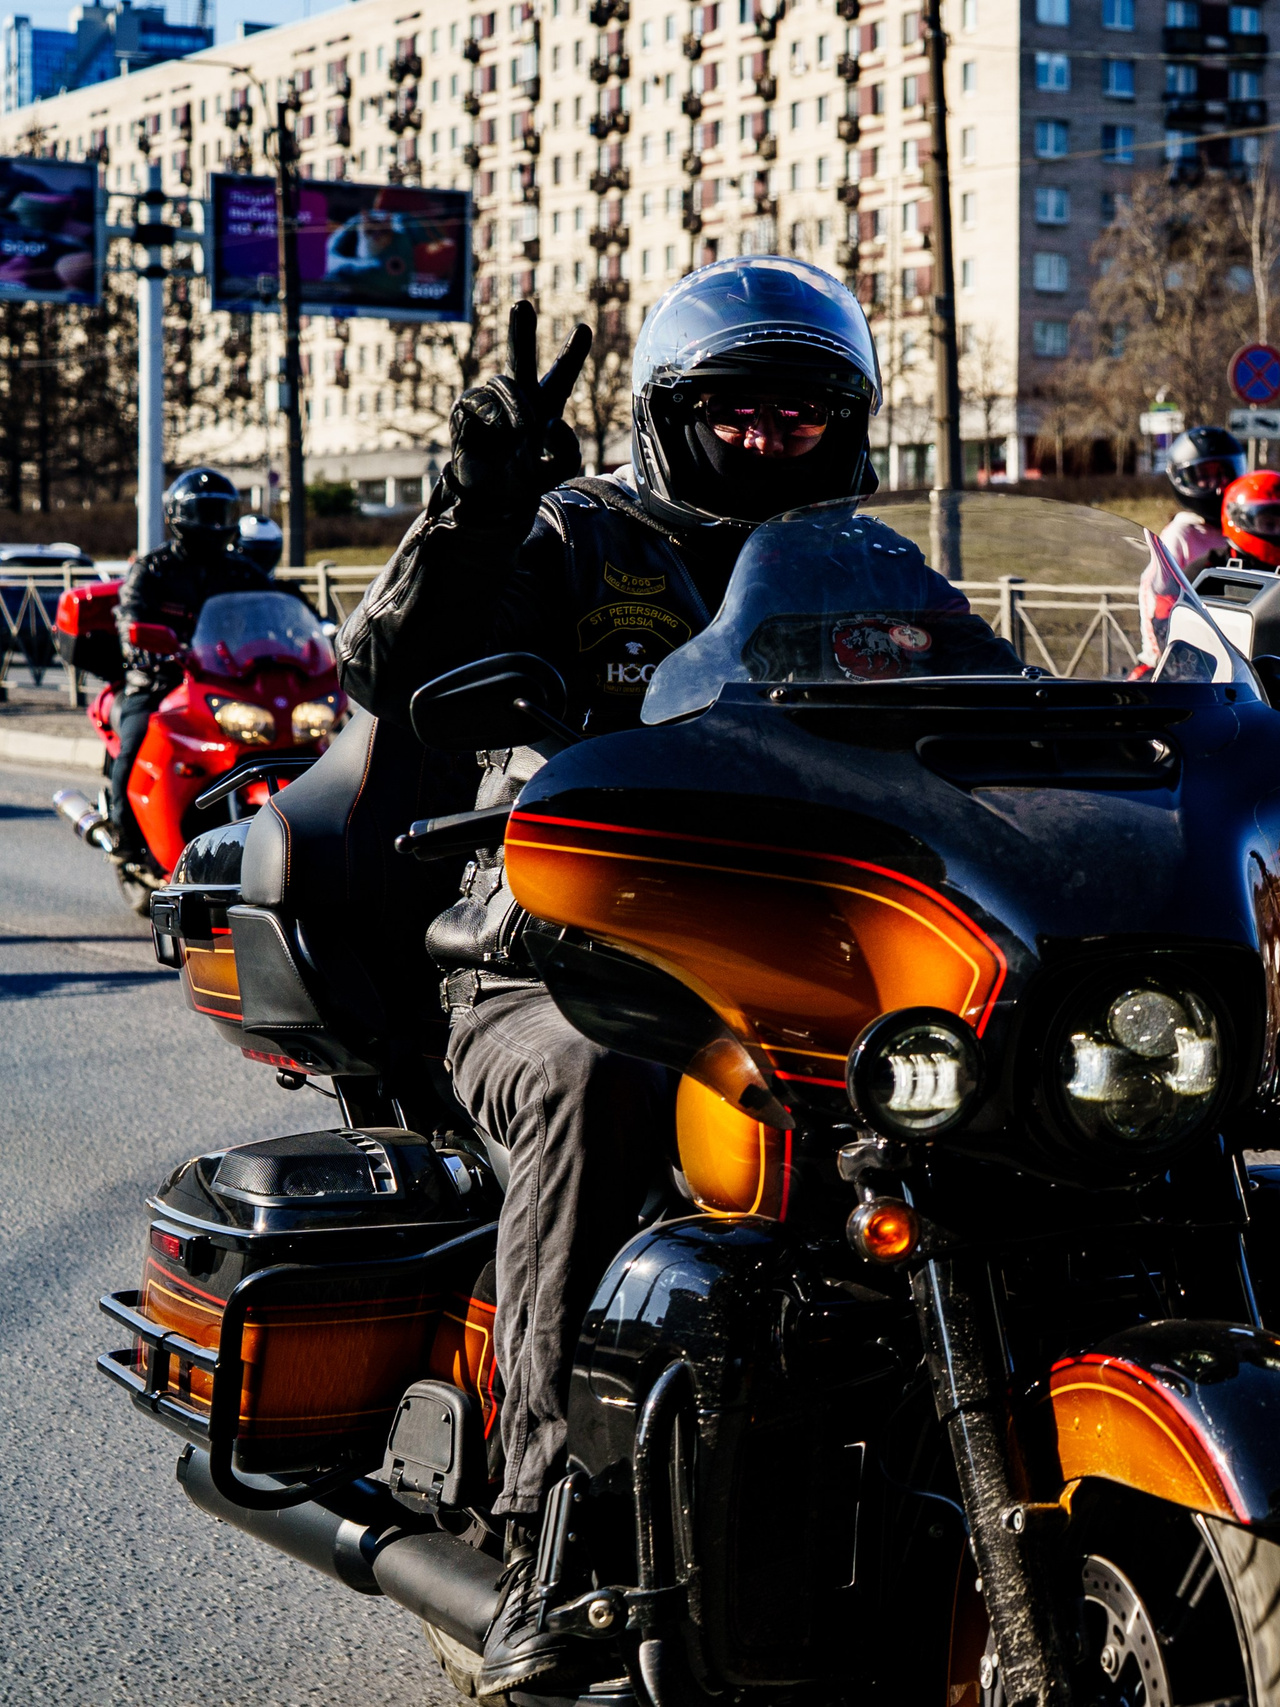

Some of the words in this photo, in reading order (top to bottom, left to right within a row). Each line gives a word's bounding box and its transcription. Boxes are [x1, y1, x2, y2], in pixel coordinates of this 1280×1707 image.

[622, 575, 651, 587] 9,000
[590, 613, 606, 626] ST.
[609, 606, 679, 628] PETERSBURG
[614, 617, 654, 628] RUSSIA
